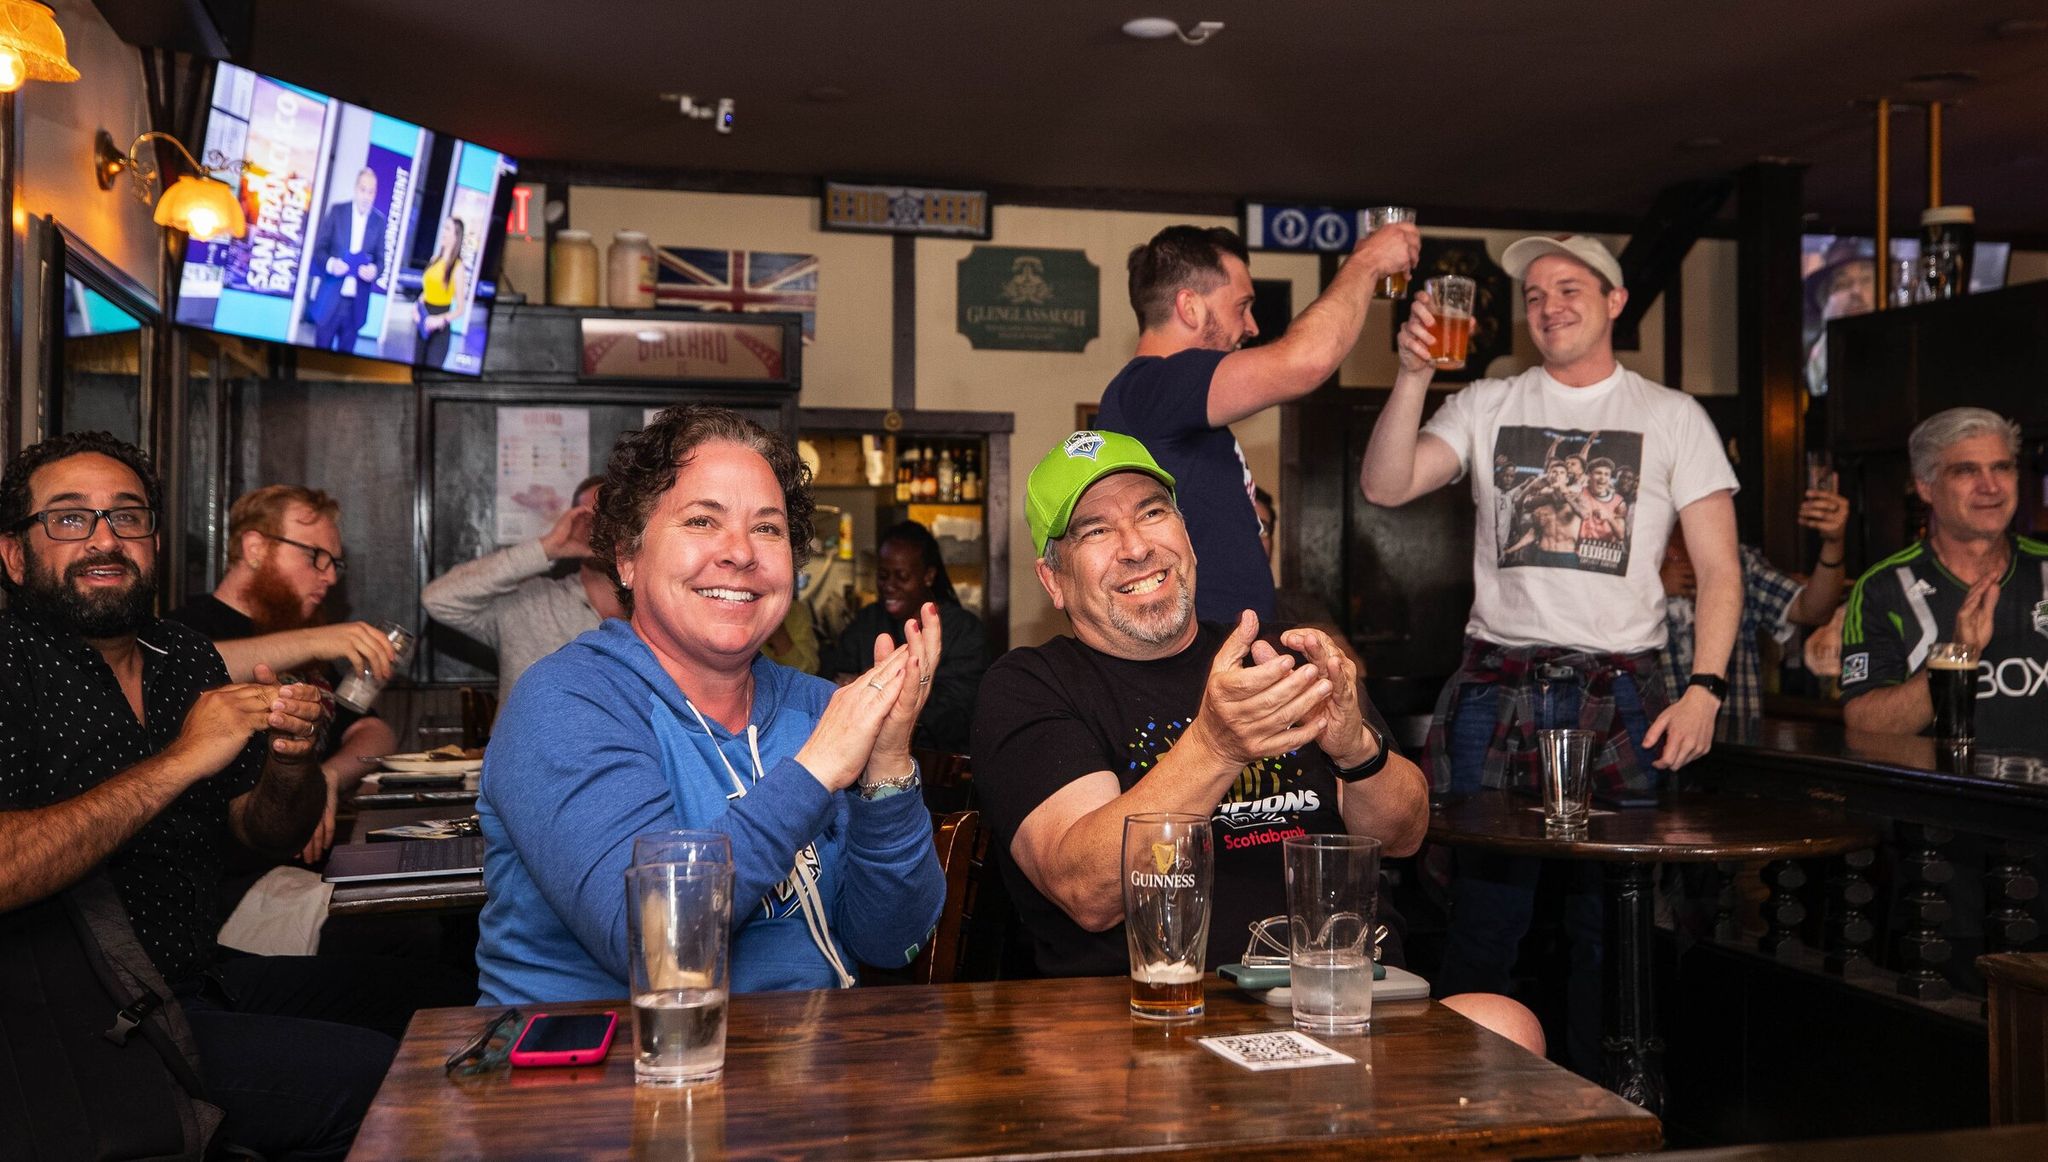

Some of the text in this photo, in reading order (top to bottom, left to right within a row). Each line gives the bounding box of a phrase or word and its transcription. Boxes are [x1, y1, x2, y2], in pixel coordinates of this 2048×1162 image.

[247, 93, 299, 289] SAN FRANCICO
[269, 179, 309, 292] BAY AREA
[966, 304, 1086, 328] GLENGLASSAUGH
[1224, 825, 1306, 850] Scotiabank
[1131, 870, 1195, 888] GUINNESS
